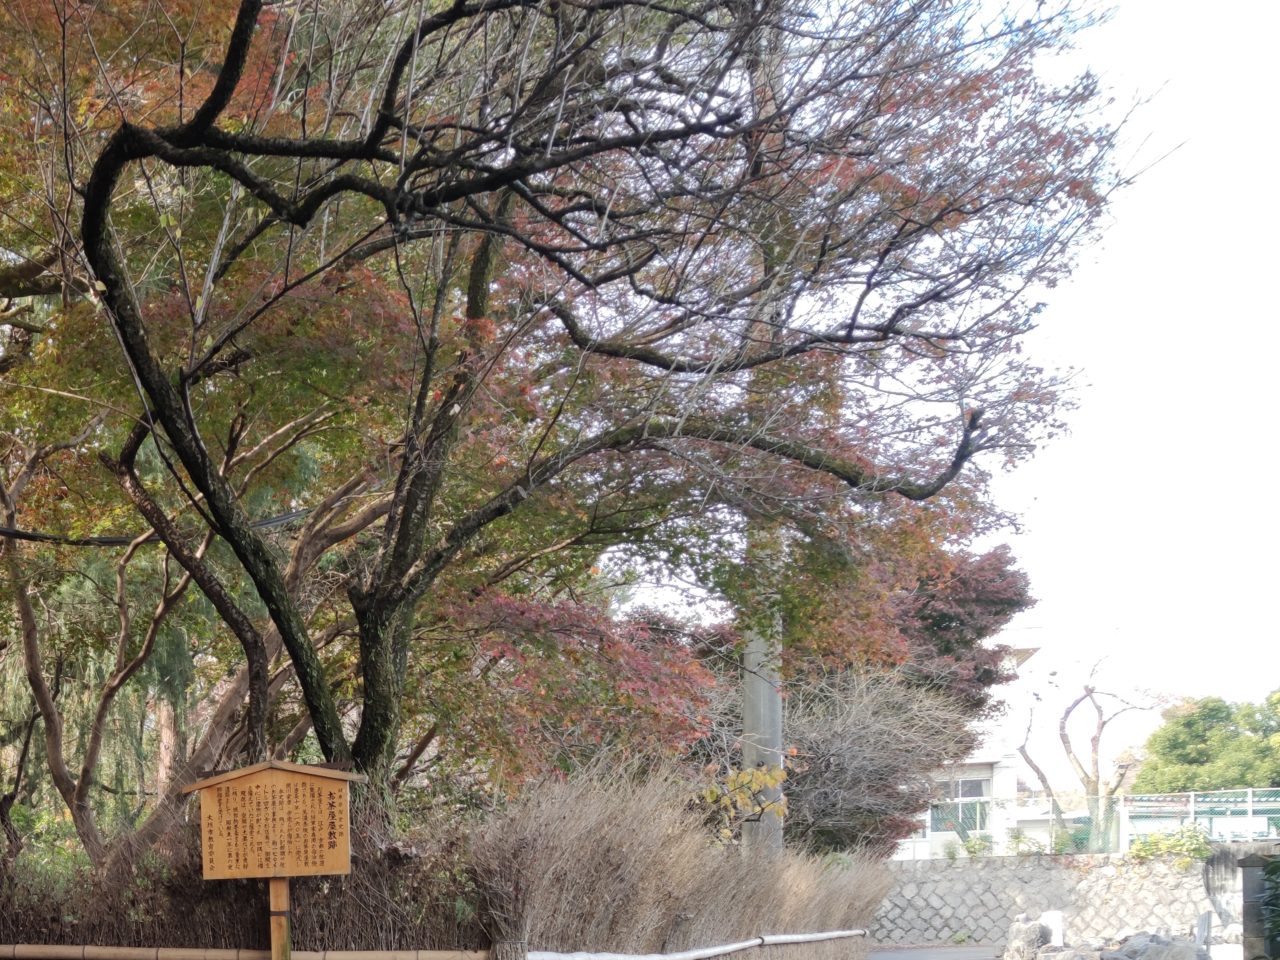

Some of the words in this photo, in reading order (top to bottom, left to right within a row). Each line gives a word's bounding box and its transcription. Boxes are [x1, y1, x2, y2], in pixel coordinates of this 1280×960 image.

[207, 814, 215, 871] 大垣市教育委員会
[327, 791, 337, 849] お茶屋屋敷跡
